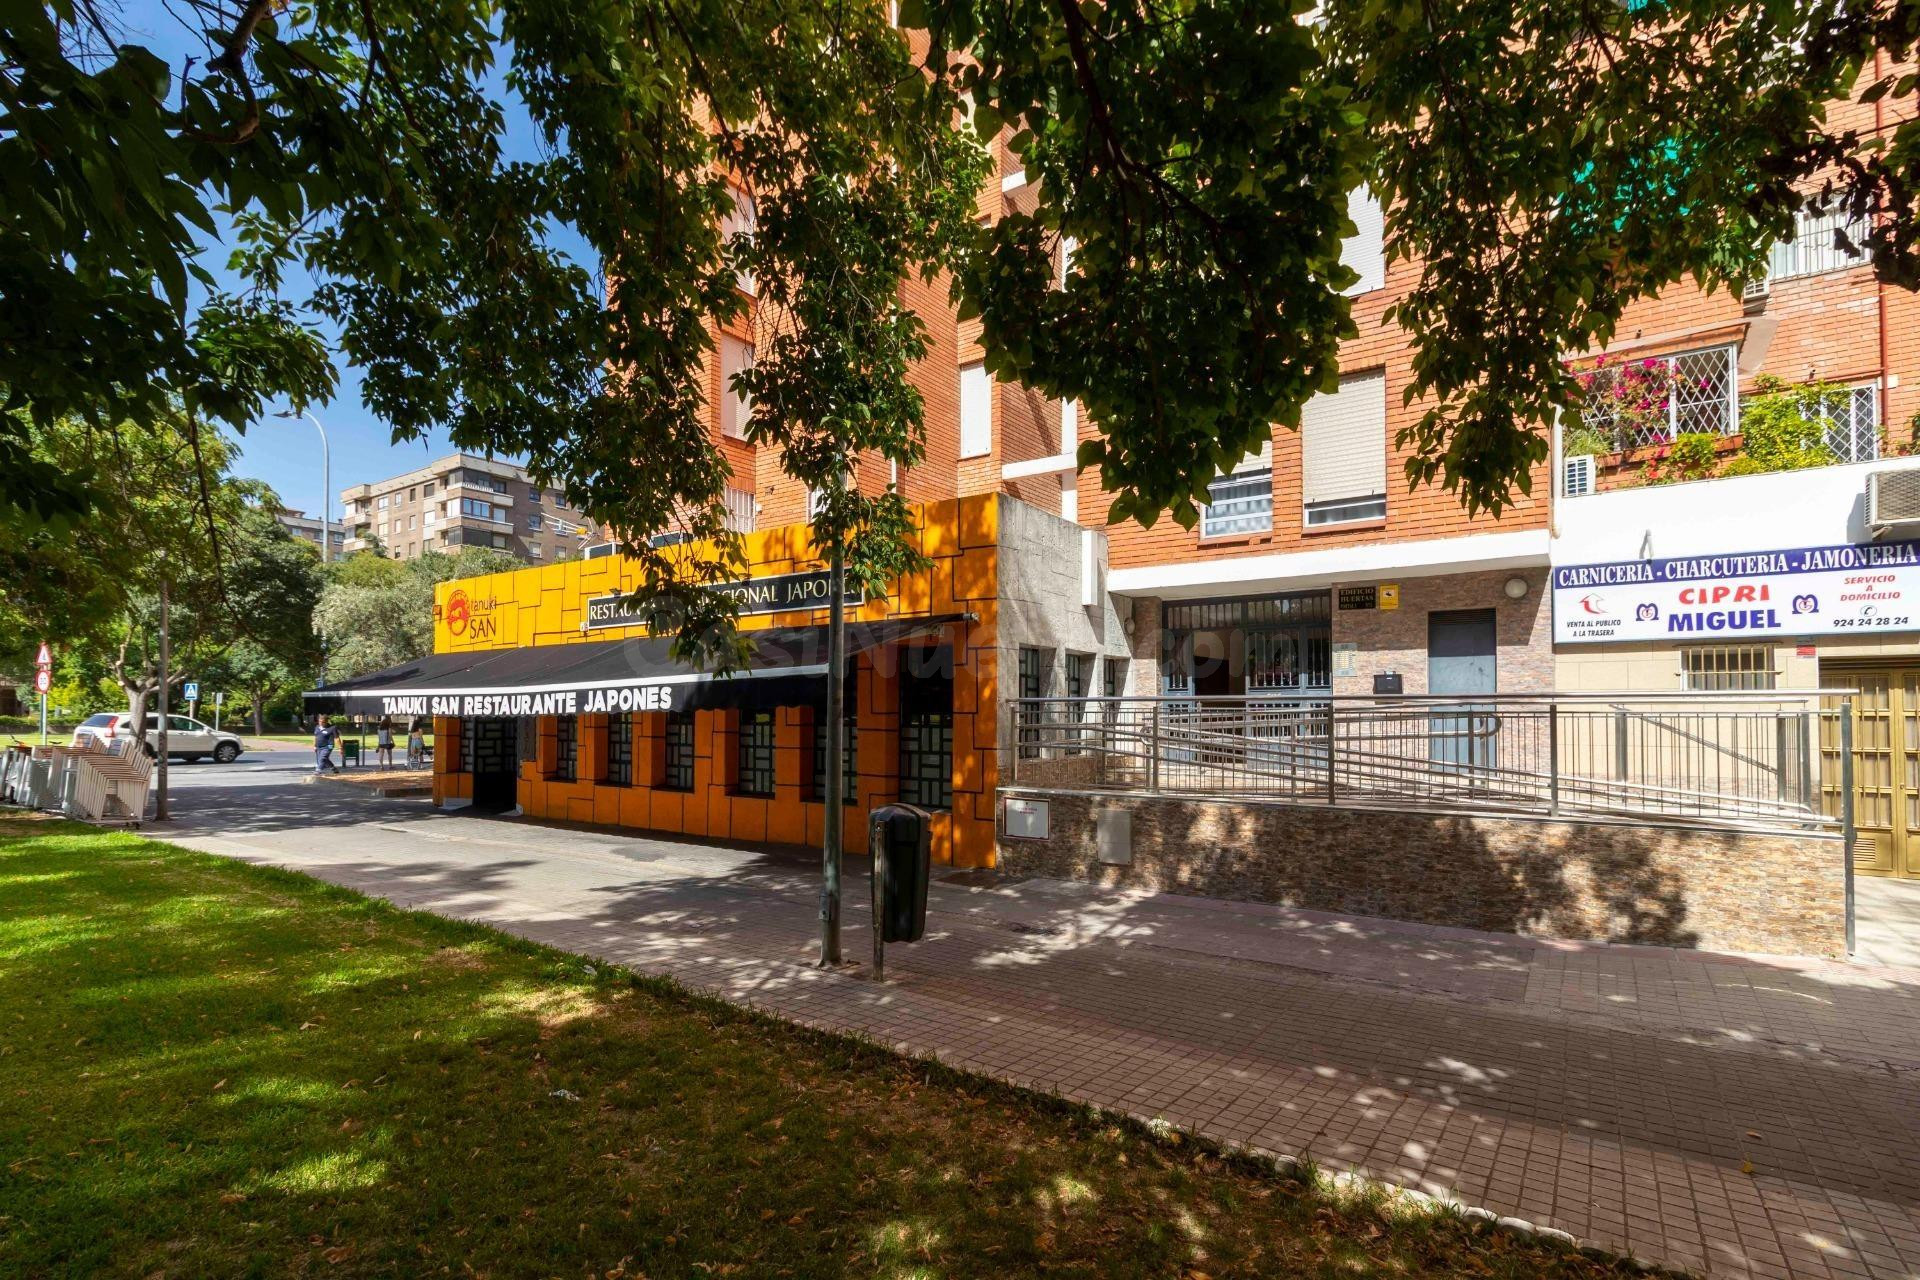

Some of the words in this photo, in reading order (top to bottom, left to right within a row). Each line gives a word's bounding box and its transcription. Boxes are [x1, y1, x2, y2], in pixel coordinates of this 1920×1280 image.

[1559, 563, 1654, 587] CARNICERIA
[1665, 553, 1789, 580] CHARCUTERIA
[1801, 543, 1918, 571] JAMONERIA
[1843, 574, 1896, 585] SERVICIO
[1678, 584, 1770, 605] CIPRI
[1865, 584, 1873, 592] A
[1840, 591, 1901, 602] DOMICILIO
[470, 596, 497, 611] tanuki
[1595, 619, 1622, 627] PUBLICO
[1667, 609, 1782, 633] MIGUEL
[1833, 619, 1854, 628] 924
[1857, 618, 1872, 626] 24
[1875, 617, 1890, 626] 28
[1894, 616, 1909, 625] 24
[470, 616, 497, 640] SAN
[1587, 629, 1615, 637] TRASERA
[382, 697, 427, 715] TANUKI
[431, 696, 459, 716] SAN
[464, 691, 577, 716] RESTAURANTE
[583, 686, 673, 713] JAPONES
